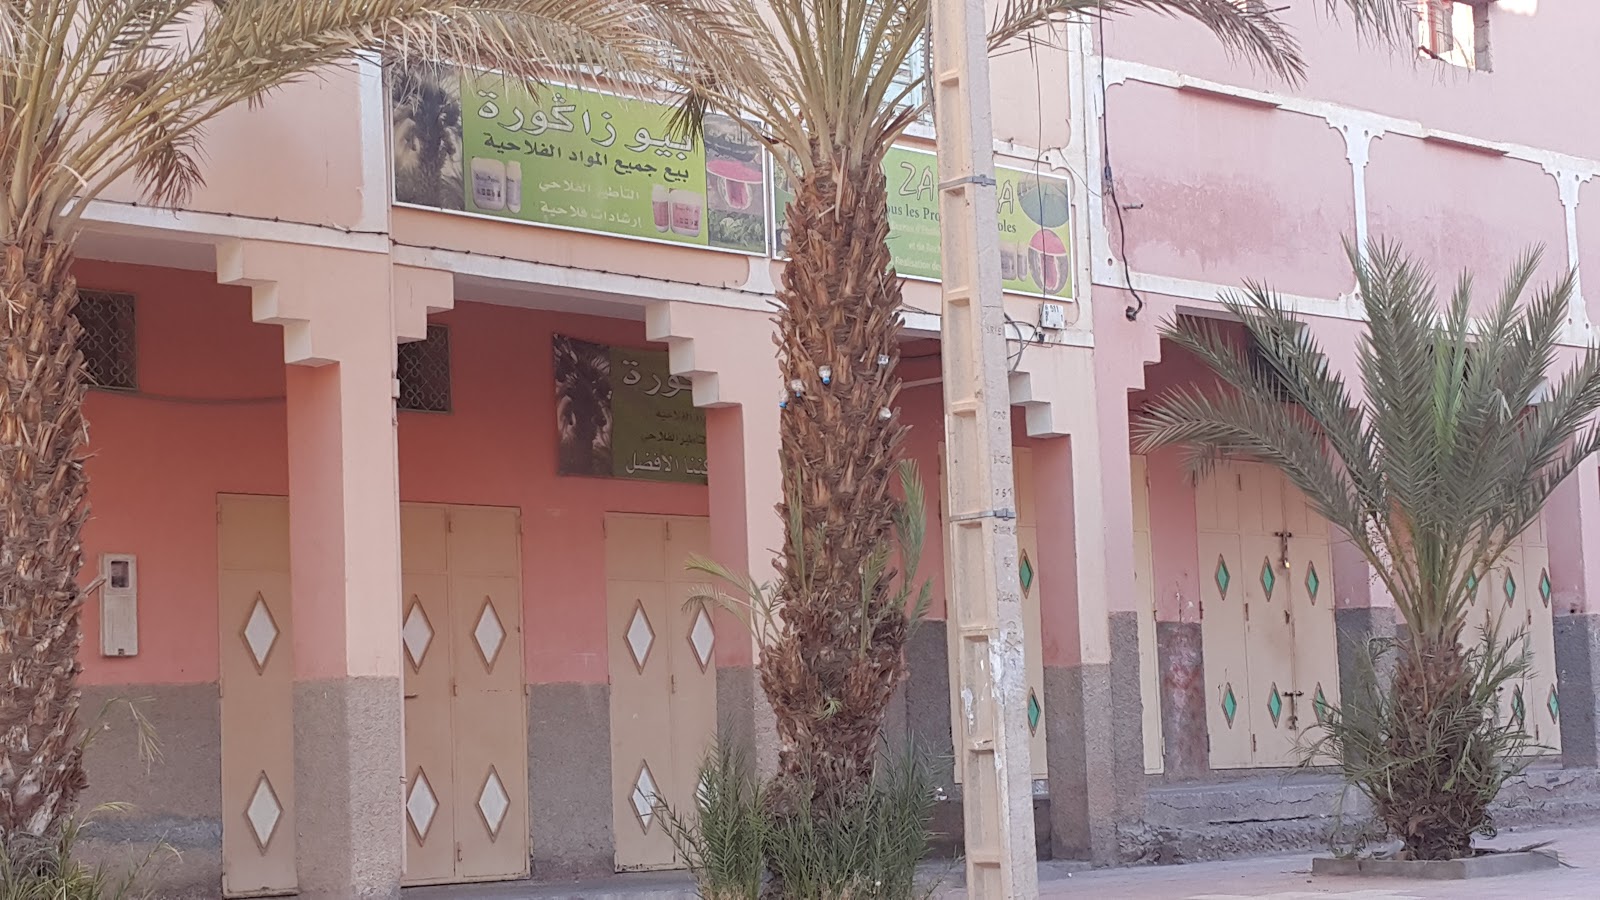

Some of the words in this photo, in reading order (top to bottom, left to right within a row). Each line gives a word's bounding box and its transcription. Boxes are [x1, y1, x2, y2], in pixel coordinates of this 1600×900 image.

[483, 132, 561, 158] الفلاحية
[569, 150, 607, 168] المواد
[614, 159, 657, 177] جميع
[664, 166, 689, 182] بيع
[905, 203, 920, 218] les
